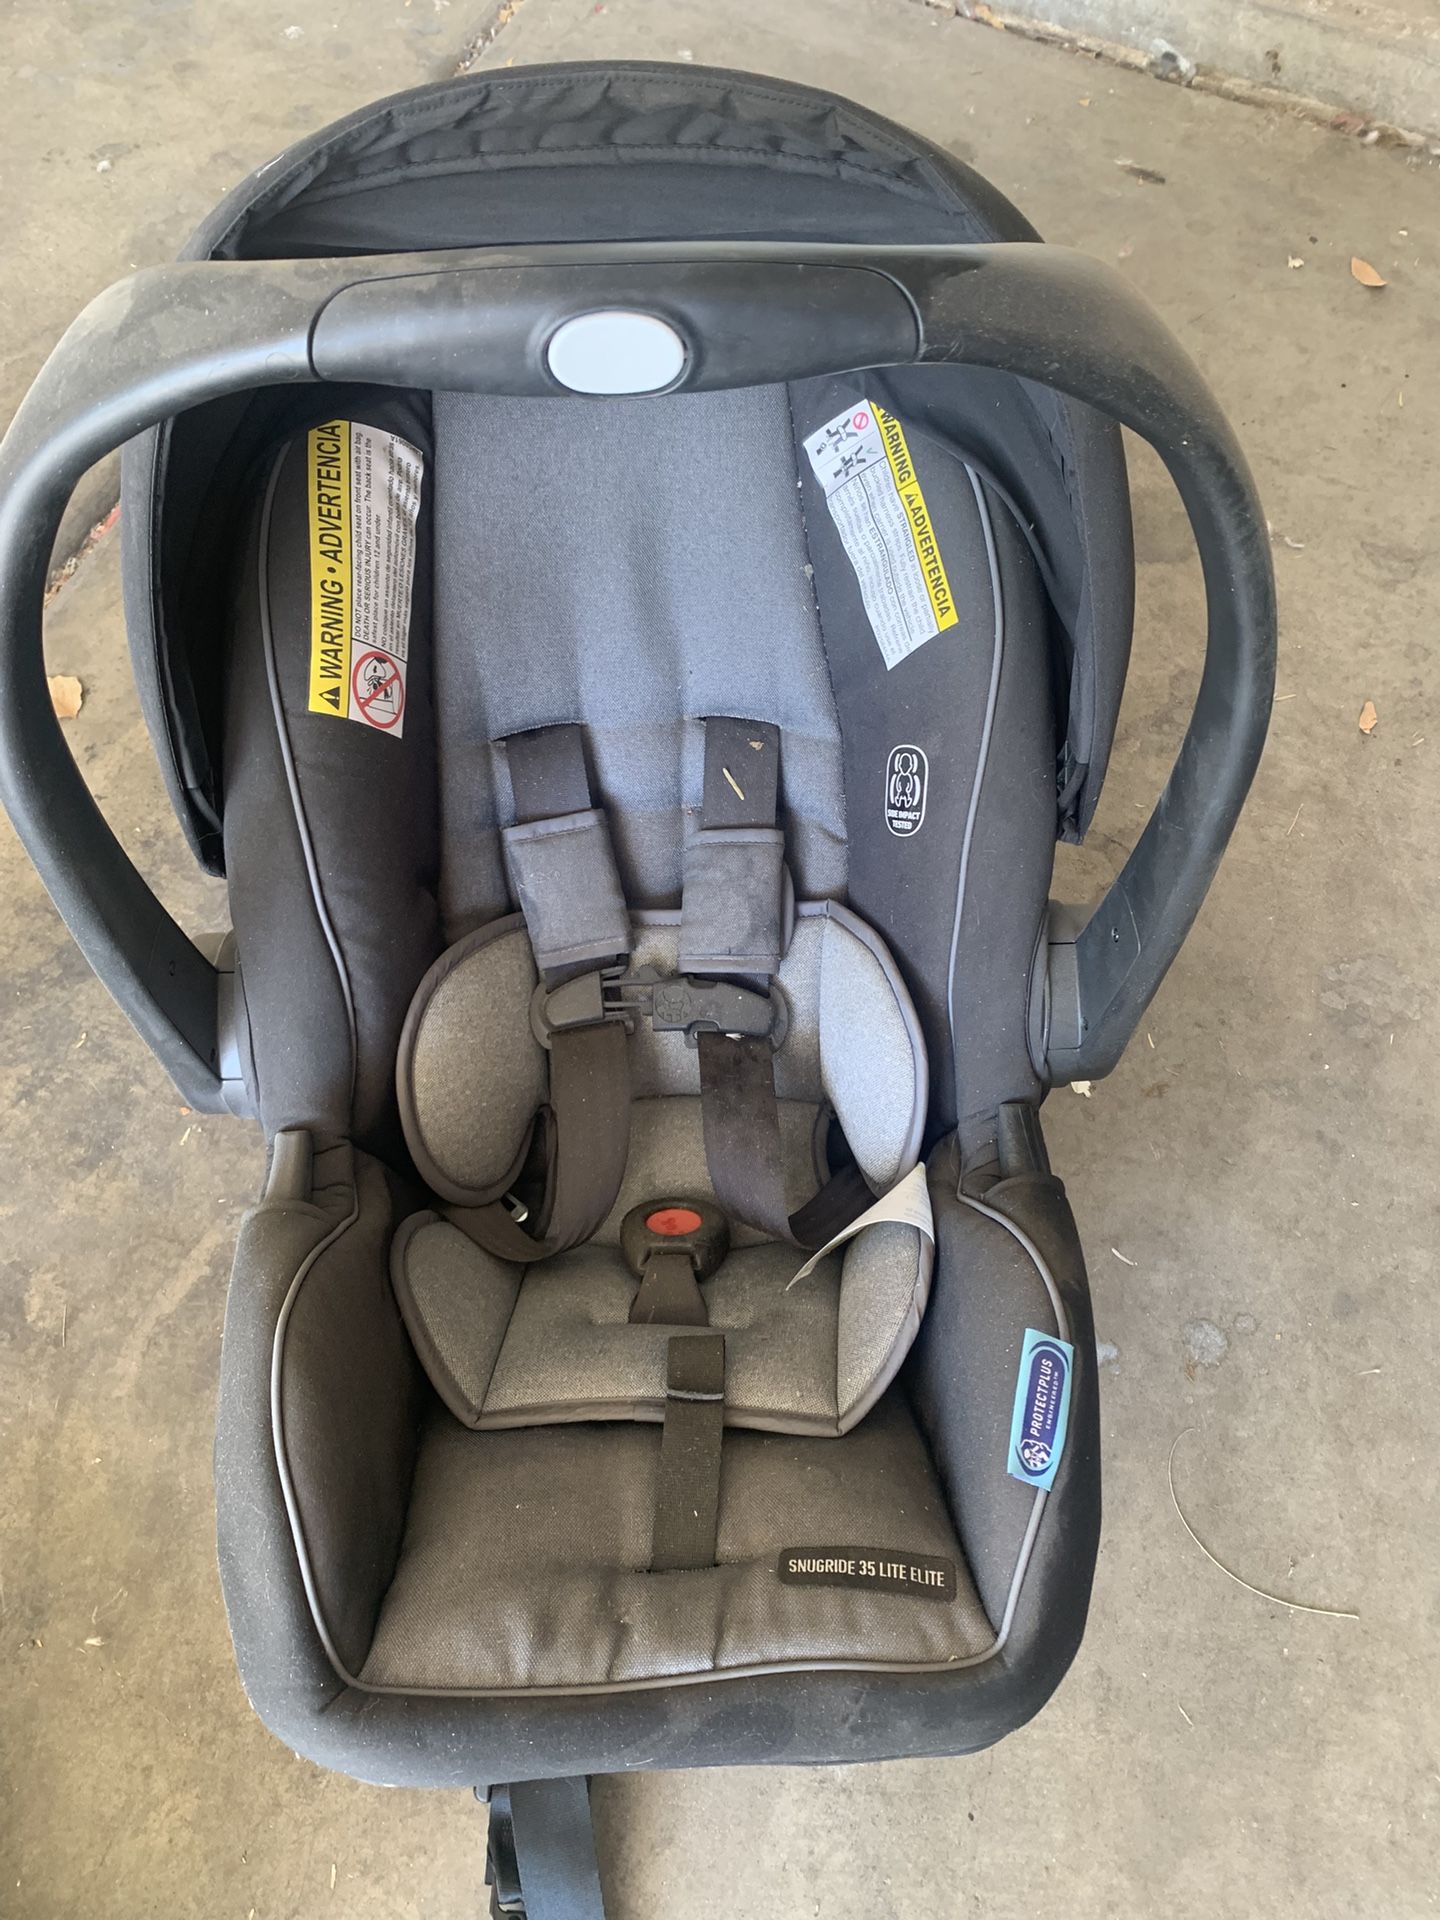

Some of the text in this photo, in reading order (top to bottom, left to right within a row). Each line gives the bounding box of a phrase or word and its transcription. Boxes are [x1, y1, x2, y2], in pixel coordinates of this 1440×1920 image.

[354, 486, 362, 502] front
[880, 412, 951, 617] WARNING ADVERTENCIA
[317, 425, 344, 679] WARNING ADVERTENCIA
[896, 511, 916, 562] STRANGLED
[355, 549, 363, 587] rear-facing
[867, 526, 894, 595] ESTRANGULADO
[364, 603, 370, 614] OR
[355, 626, 360, 638] DO
[899, 810, 921, 820] IMPACT
[1030, 1358, 1053, 1437] PROTECTPLUS
[788, 1558, 945, 1587] SNUGRIDE 35 LITE ELITE
